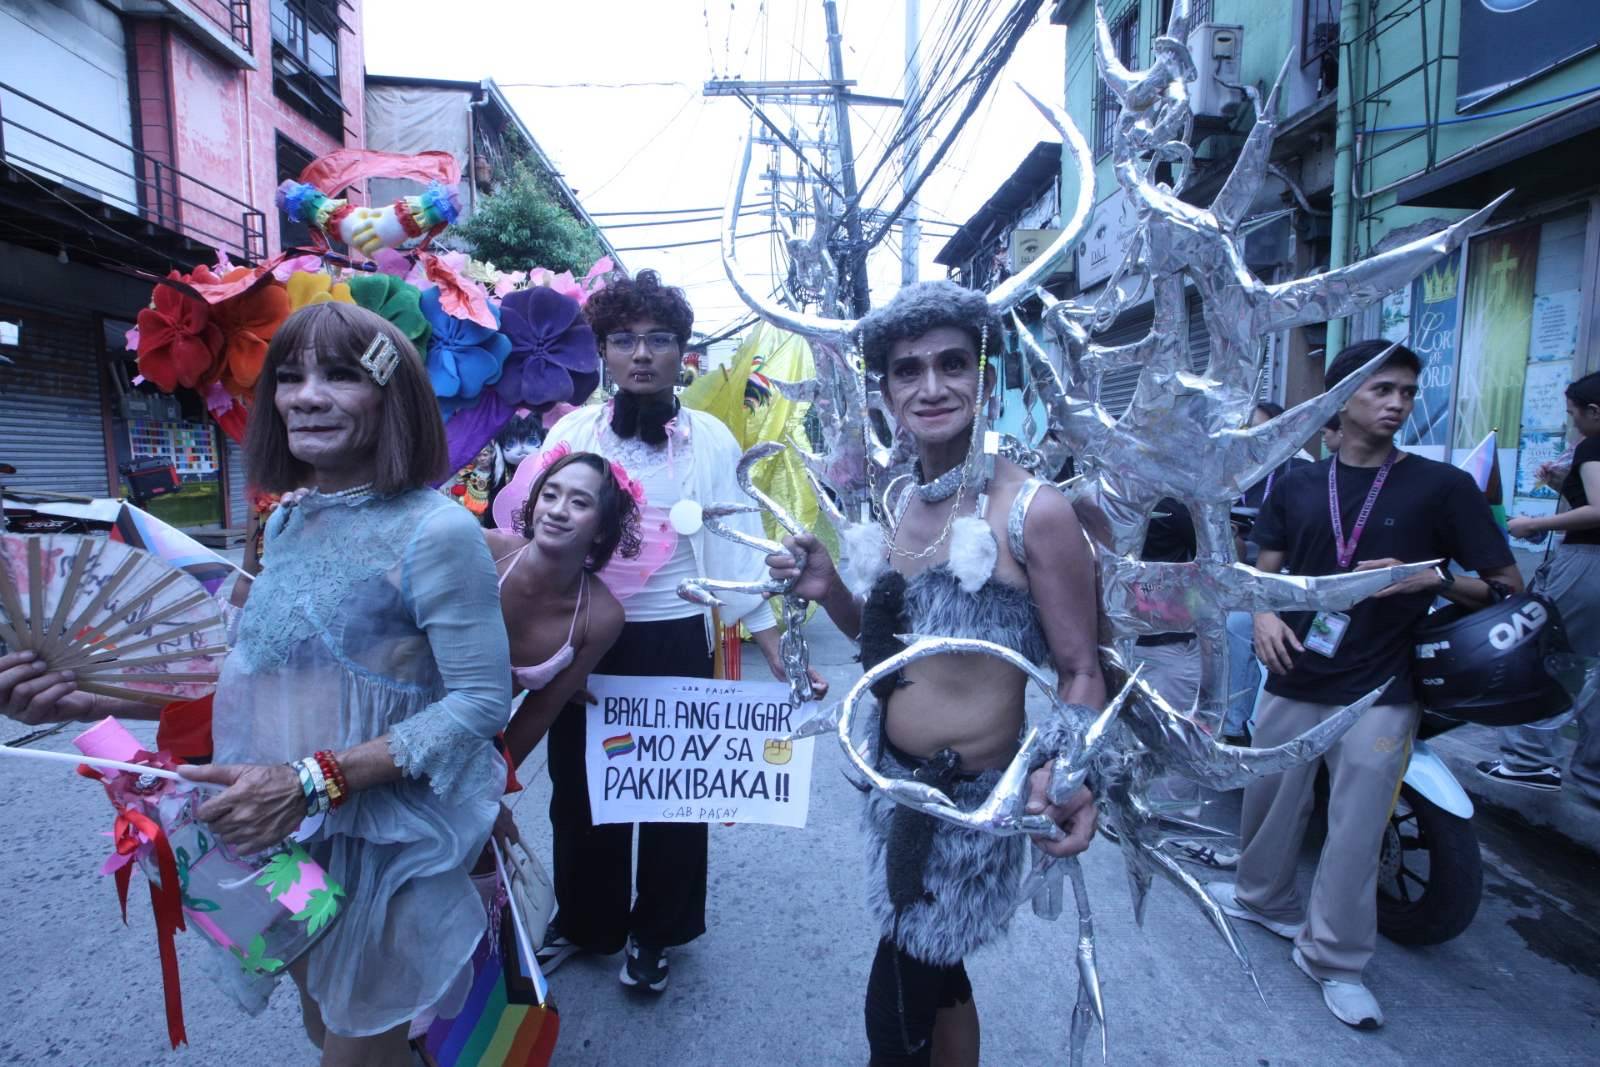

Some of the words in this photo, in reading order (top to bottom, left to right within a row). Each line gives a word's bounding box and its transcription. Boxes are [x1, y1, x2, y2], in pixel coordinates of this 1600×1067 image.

[1415, 311, 1453, 353] LOR
[1488, 601, 1548, 650] EVO
[675, 701, 720, 730] ANG
[724, 703, 793, 733] LUGAR
[637, 735, 675, 762] MO
[680, 734, 722, 762] AY
[724, 737, 754, 762] SA
[662, 805, 693, 819] GAB
